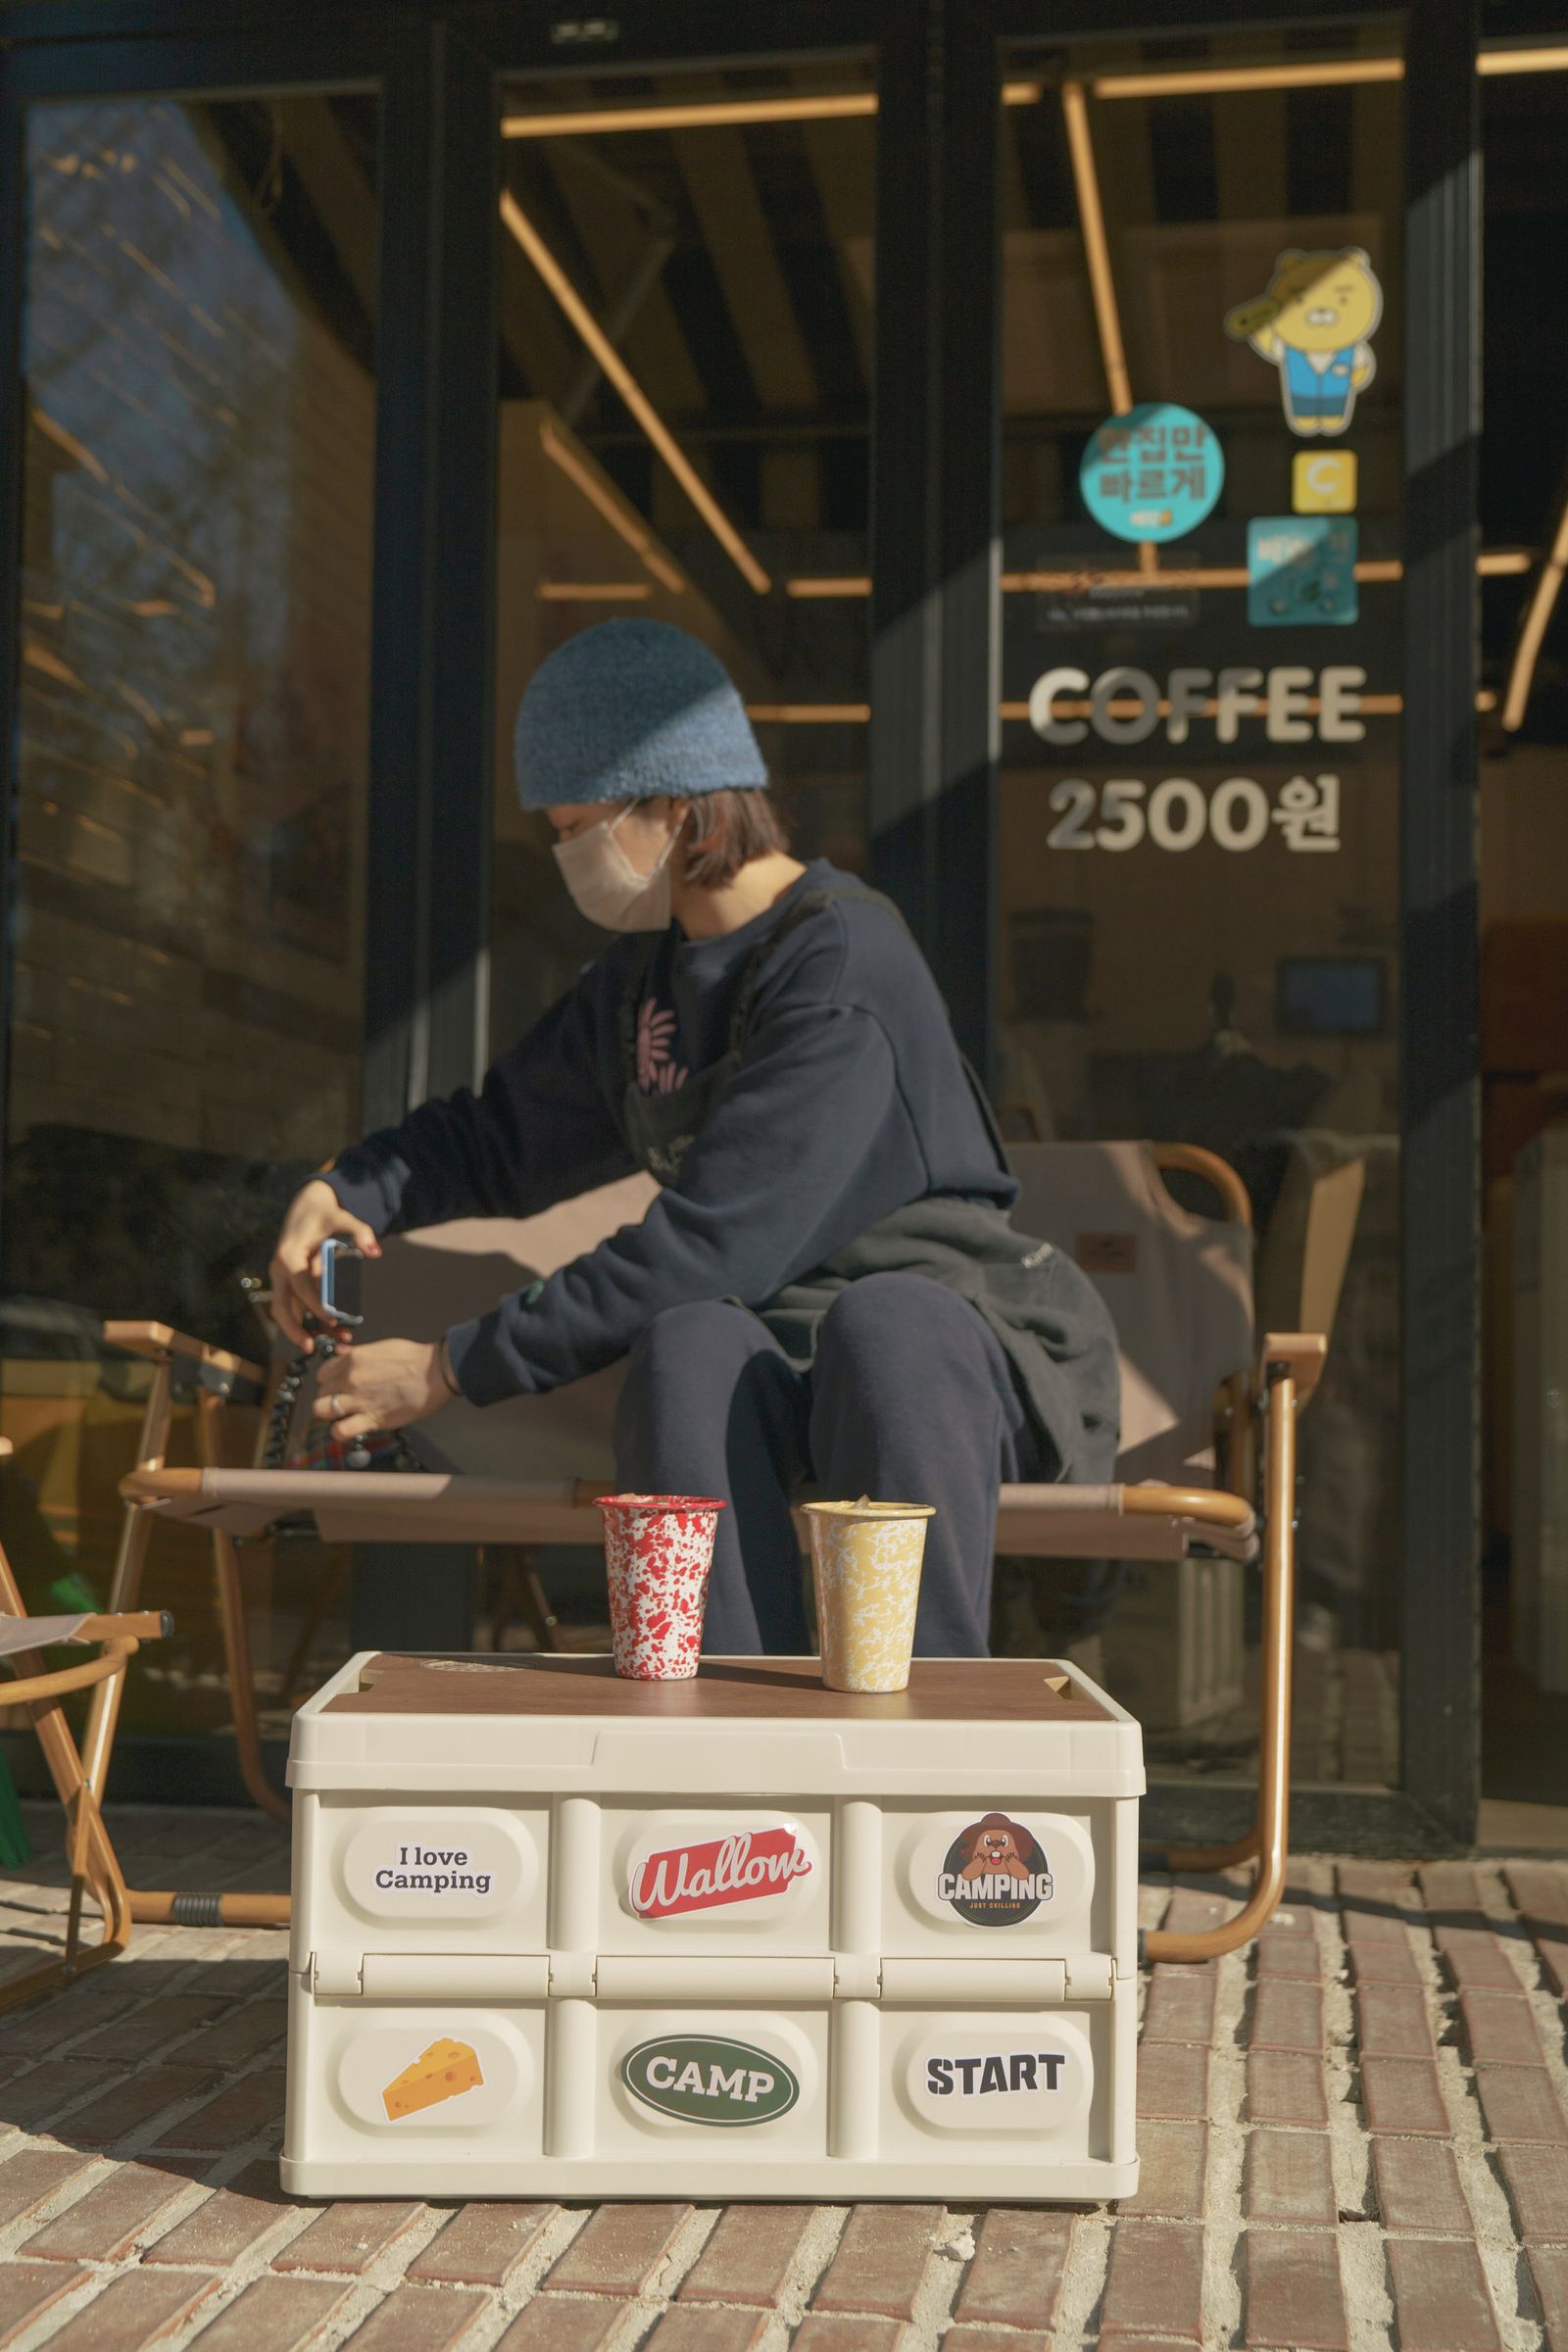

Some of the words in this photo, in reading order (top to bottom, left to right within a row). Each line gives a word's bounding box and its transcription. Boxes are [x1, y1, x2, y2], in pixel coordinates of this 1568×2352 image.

[1028, 665, 1367, 745] COFFEE
[1046, 773, 1342, 853] 2500원
[399, 1847, 409, 1866] I
[415, 1846, 468, 1866] love
[374, 1870, 491, 1893] Camping
[938, 1872, 1054, 1901] CAMPING
[645, 2056, 774, 2103] CAMP
[926, 2054, 1065, 2096] START
